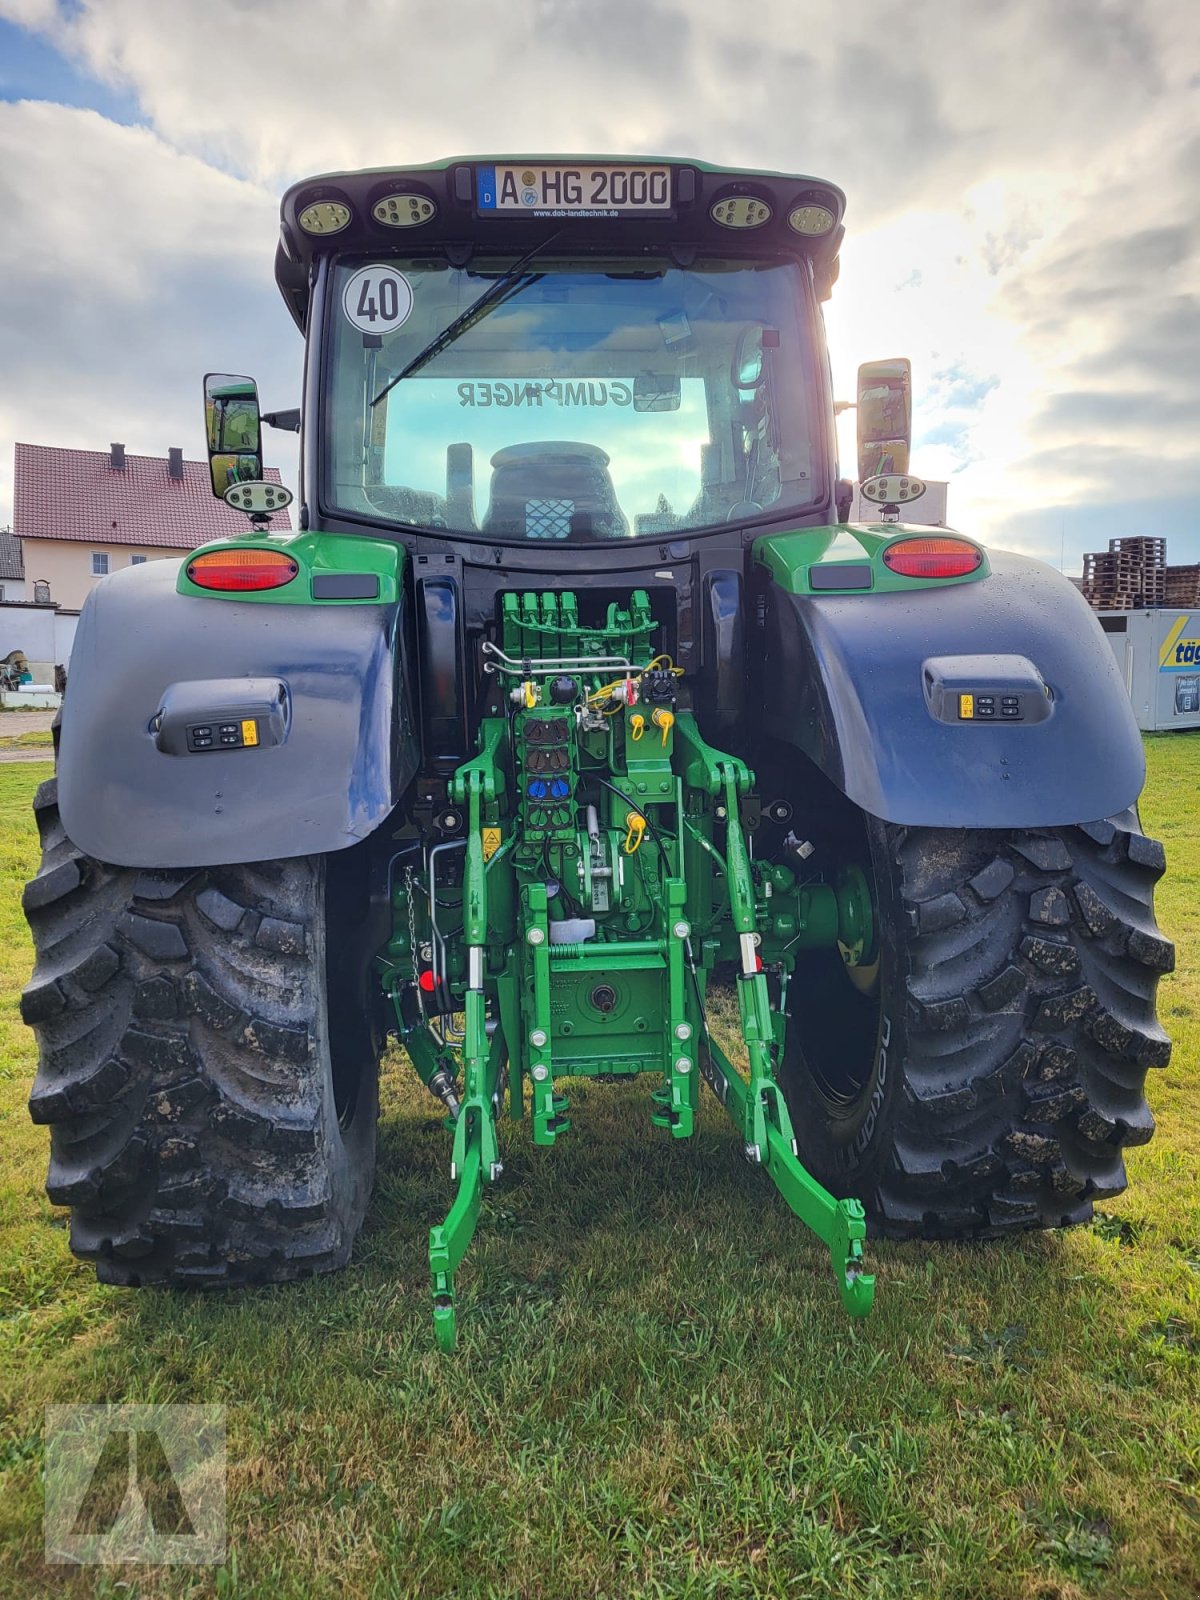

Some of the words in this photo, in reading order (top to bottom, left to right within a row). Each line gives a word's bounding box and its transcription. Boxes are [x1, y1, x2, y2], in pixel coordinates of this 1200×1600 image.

[484, 193, 491, 203] D
[500, 171, 519, 204] A
[541, 171, 582, 204] HG
[590, 171, 667, 205] 2000
[357, 278, 399, 322] 40
